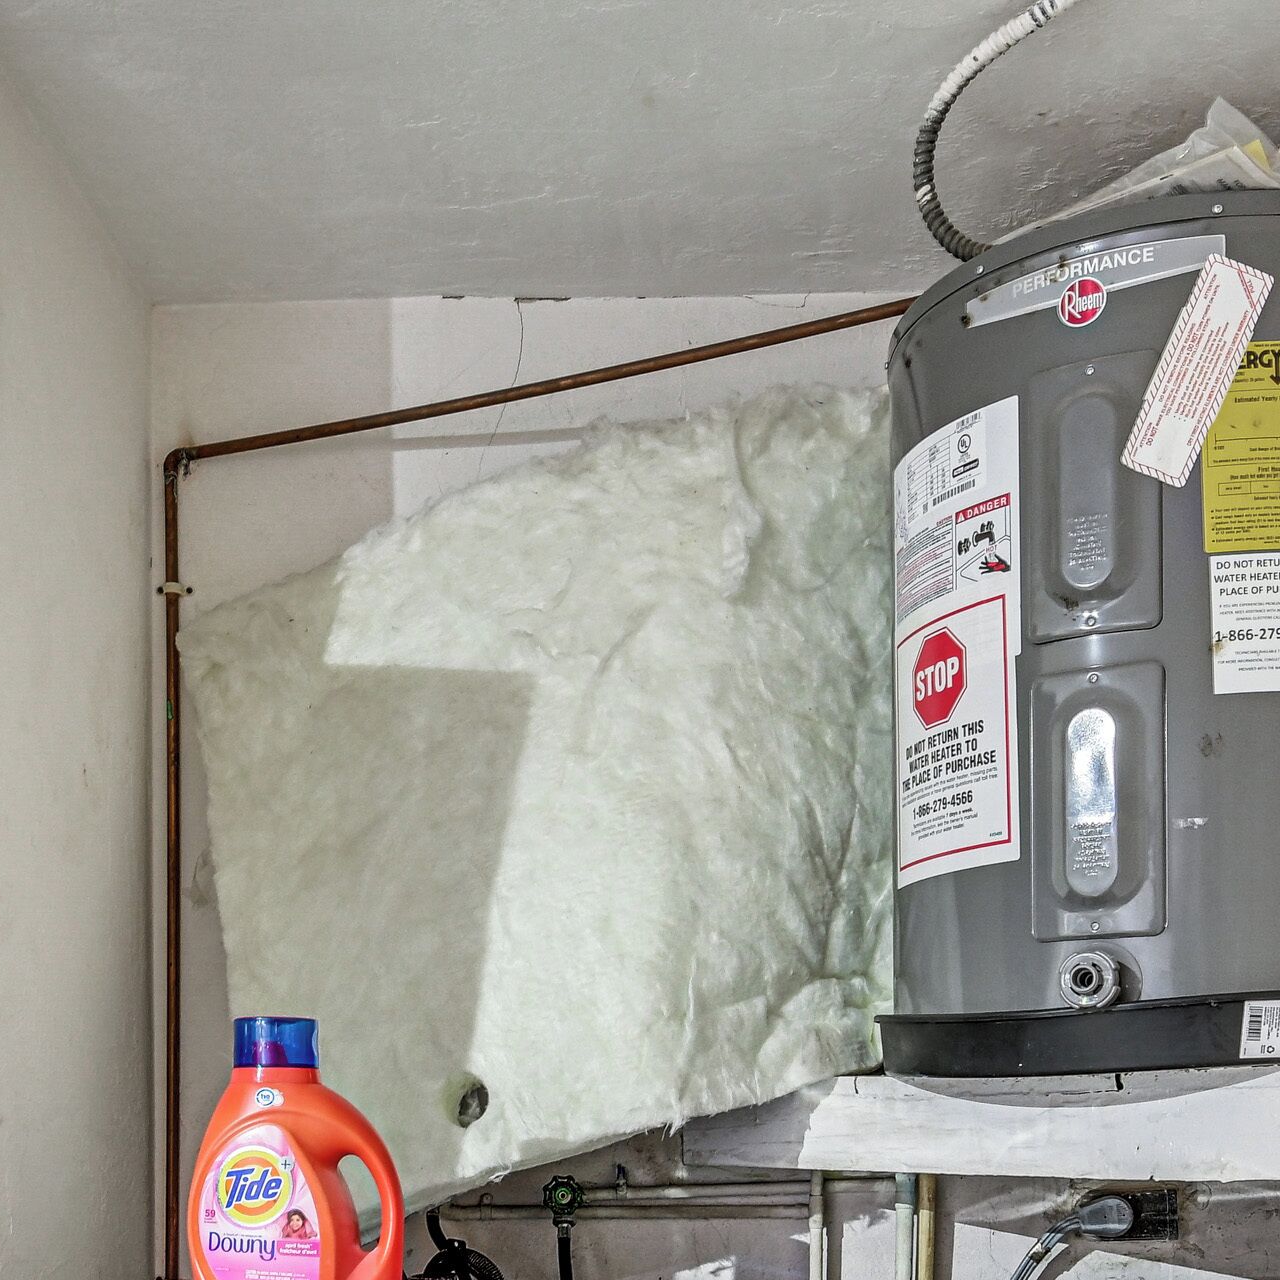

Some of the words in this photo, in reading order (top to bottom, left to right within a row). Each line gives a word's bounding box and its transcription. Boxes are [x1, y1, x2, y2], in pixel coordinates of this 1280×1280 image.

[1012, 247, 1154, 298] PERFORMANCE
[1064, 281, 1104, 320] Rheem
[961, 439, 968, 448] UL
[1138, 421, 1152, 448] ATTENTION
[966, 496, 1007, 518] DANGER
[986, 545, 997, 553] HOT
[1214, 574, 1247, 583] WATER
[1216, 561, 1230, 569] DO
[1234, 560, 1253, 569] NOT
[1220, 587, 1248, 596] PLACE
[1251, 586, 1263, 595] OF
[916, 656, 960, 701] STOP
[906, 745, 913, 760] DO
[914, 739, 926, 755] NOT
[928, 727, 959, 748] RETURN
[962, 720, 984, 737] THIS
[909, 754, 929, 773] WATER
[931, 743, 962, 763] HEATER
[965, 738, 977, 753] TO
[902, 776, 911, 793] THE
[912, 769, 931, 789] PLACE
[933, 765, 943, 779] OF
[945, 750, 996, 775] PURCHASE
[913, 790, 973, 820] 1-866-279-4566
[225, 1167, 282, 1209] Tide
[205, 1209, 215, 1218] 59
[209, 1232, 275, 1261] Downy
